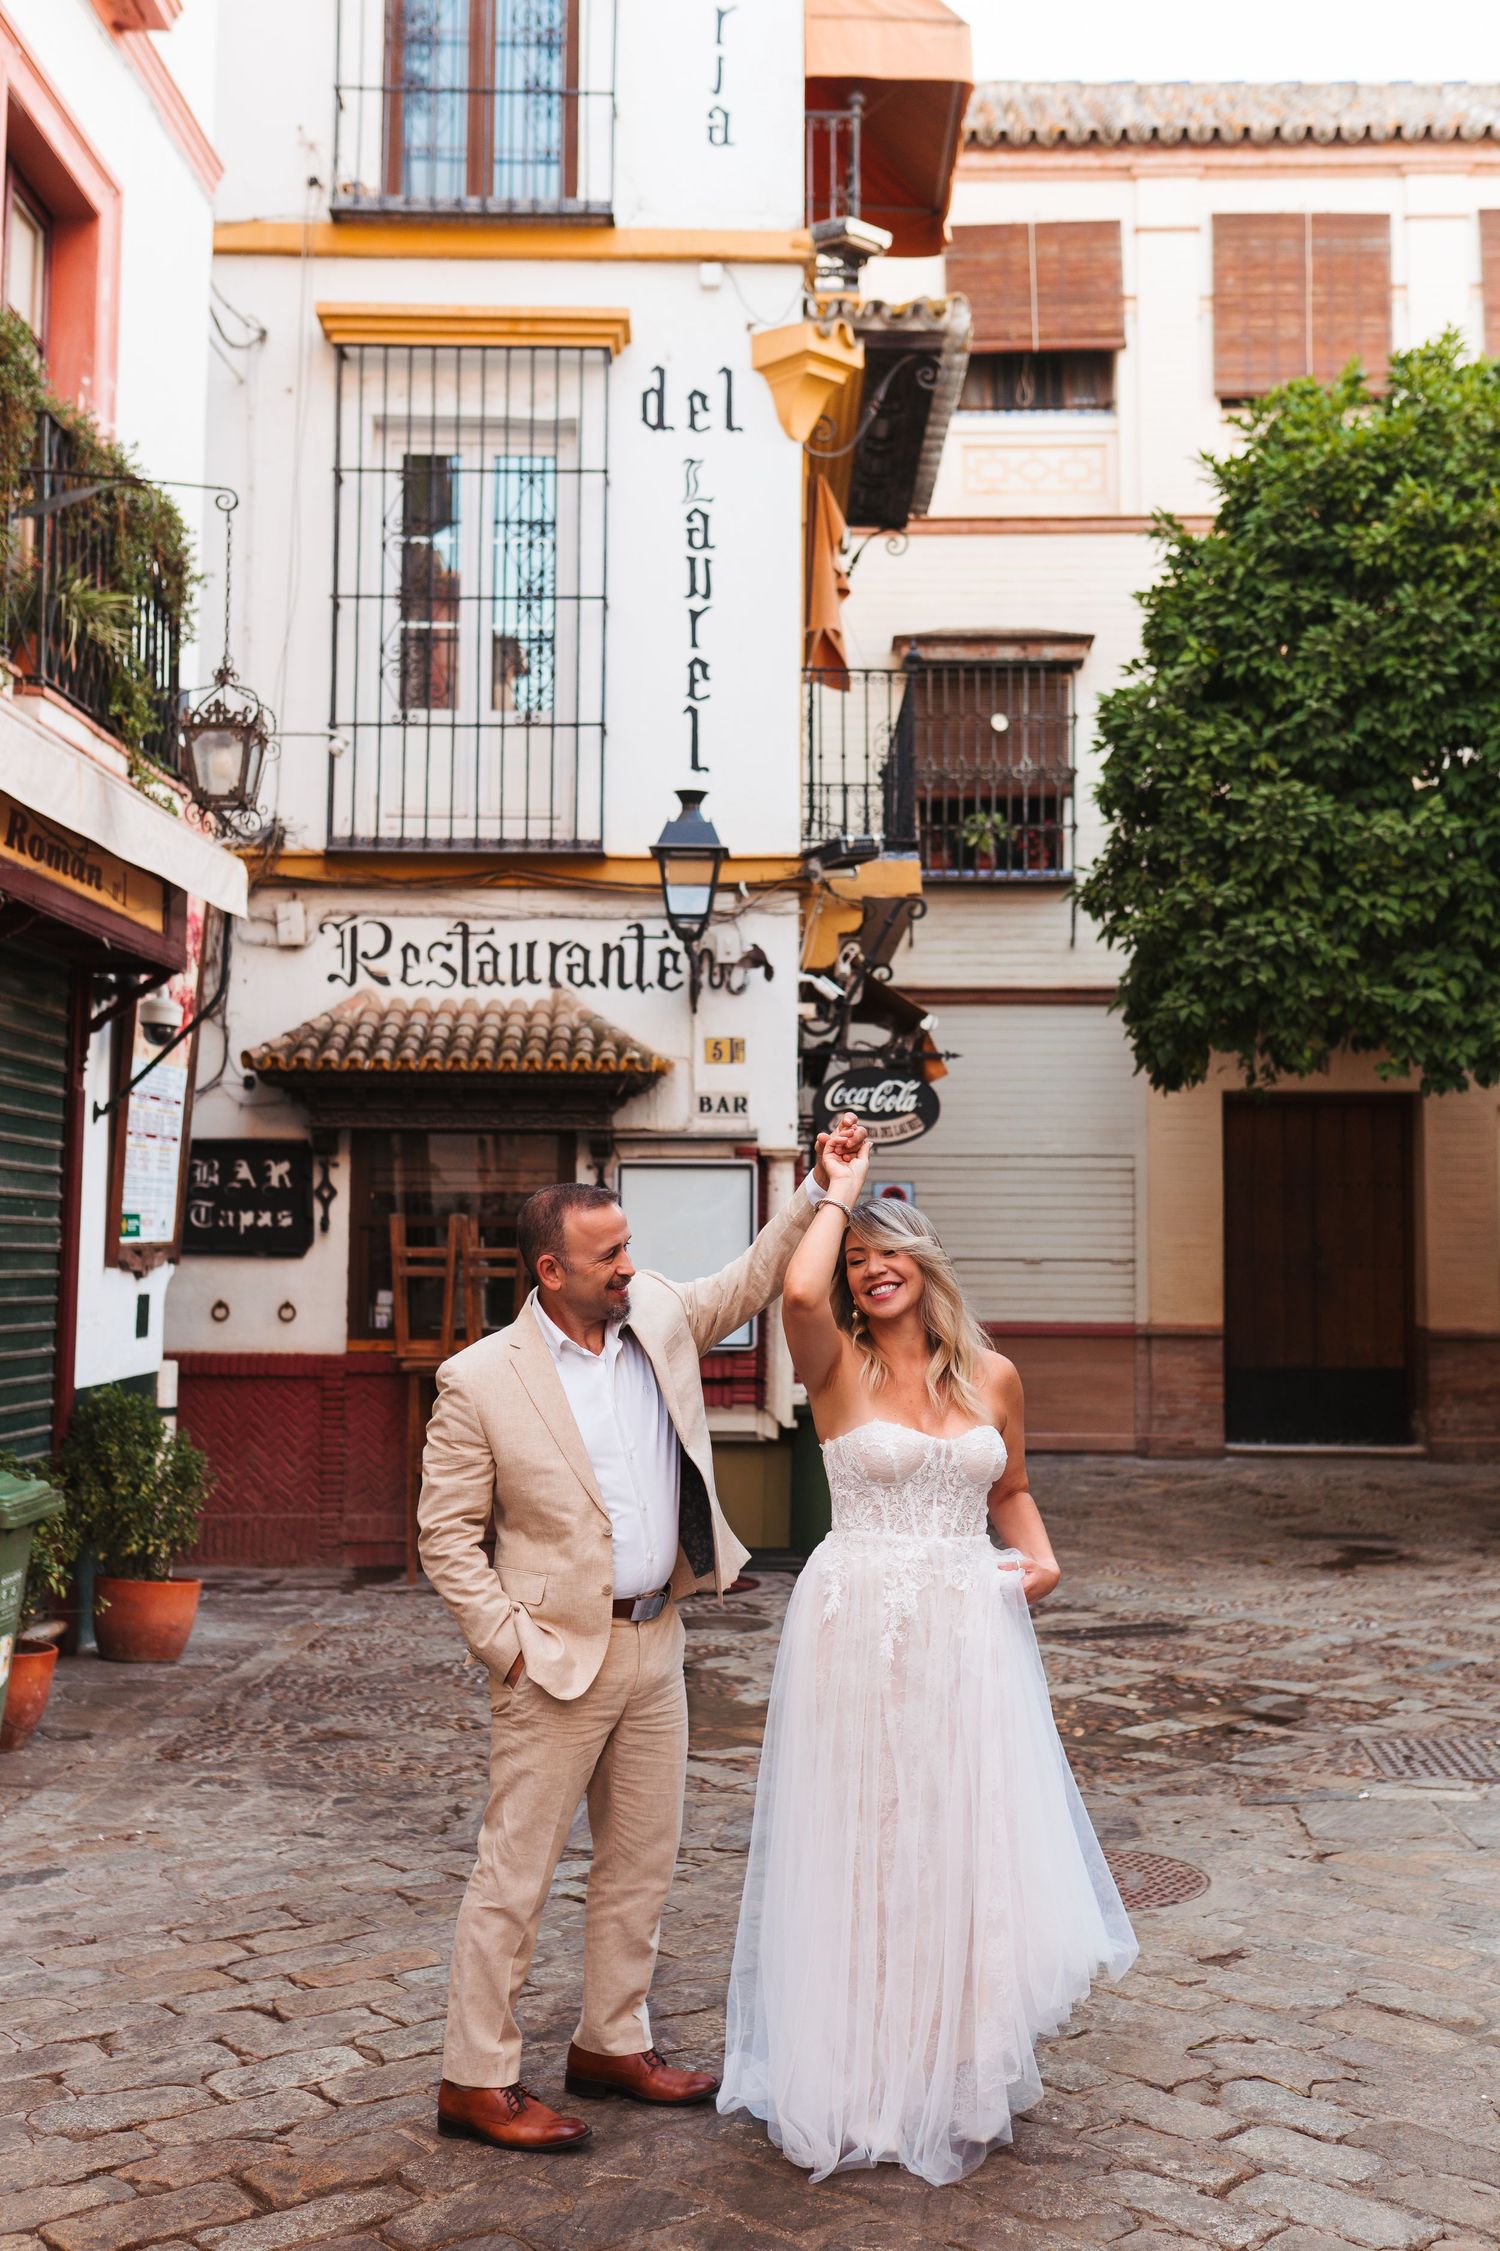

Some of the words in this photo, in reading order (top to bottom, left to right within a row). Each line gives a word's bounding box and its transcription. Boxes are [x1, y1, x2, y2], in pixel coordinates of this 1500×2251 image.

[641, 365, 743, 432] del
[682, 458, 716, 773] Laurel
[319, 914, 684, 993] Restaurante
[699, 1096, 748, 1113] BAR
[192, 1159, 292, 1190] BAR
[190, 1200, 293, 1235] Tapas
